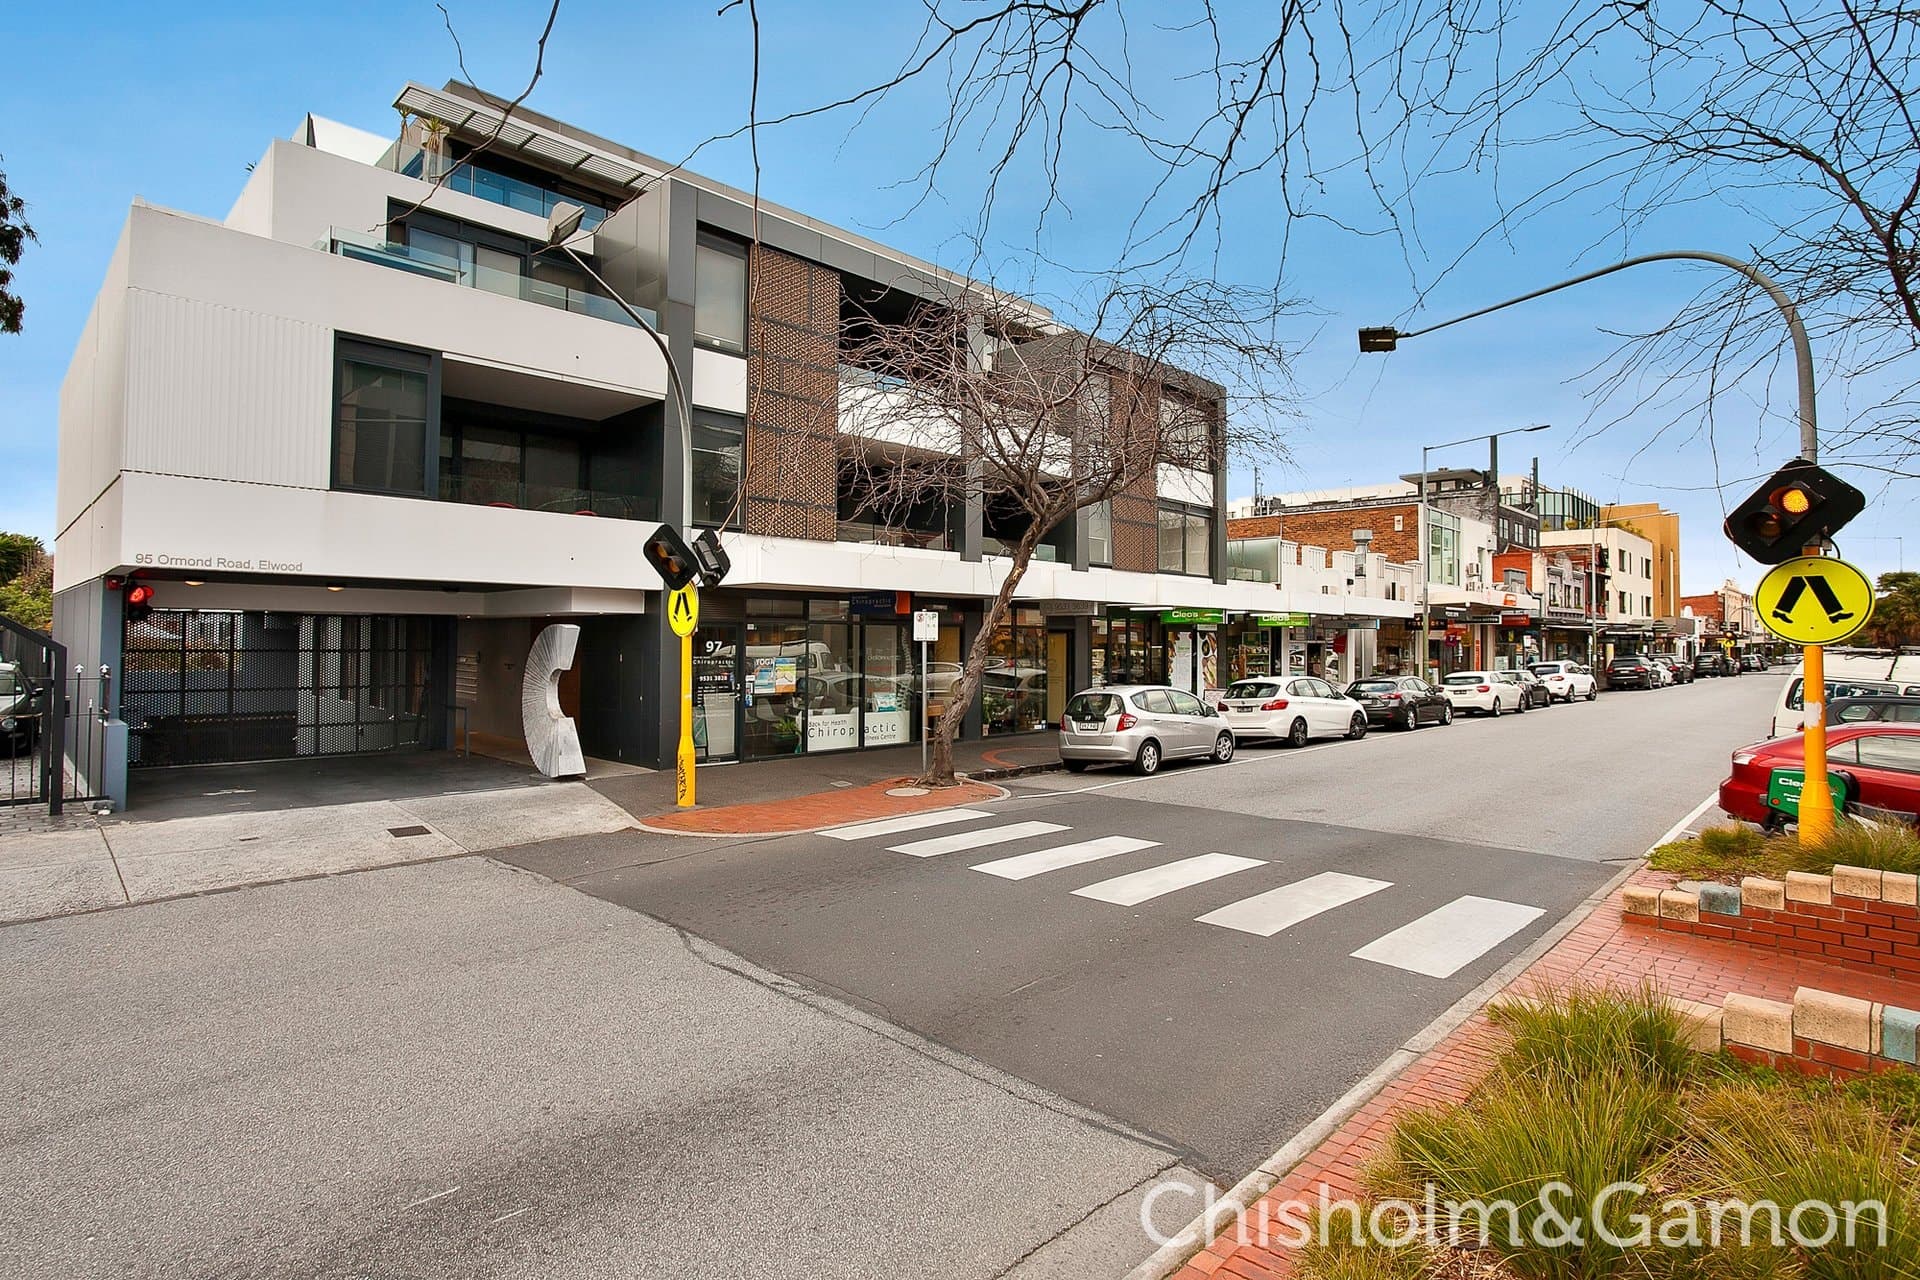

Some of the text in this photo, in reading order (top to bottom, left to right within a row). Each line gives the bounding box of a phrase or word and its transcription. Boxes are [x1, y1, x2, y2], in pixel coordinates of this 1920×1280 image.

[135, 553, 303, 572] 95 Ormond Road, Elwood
[705, 640, 723, 653] 97
[692, 658, 735, 666] Chiropractic
